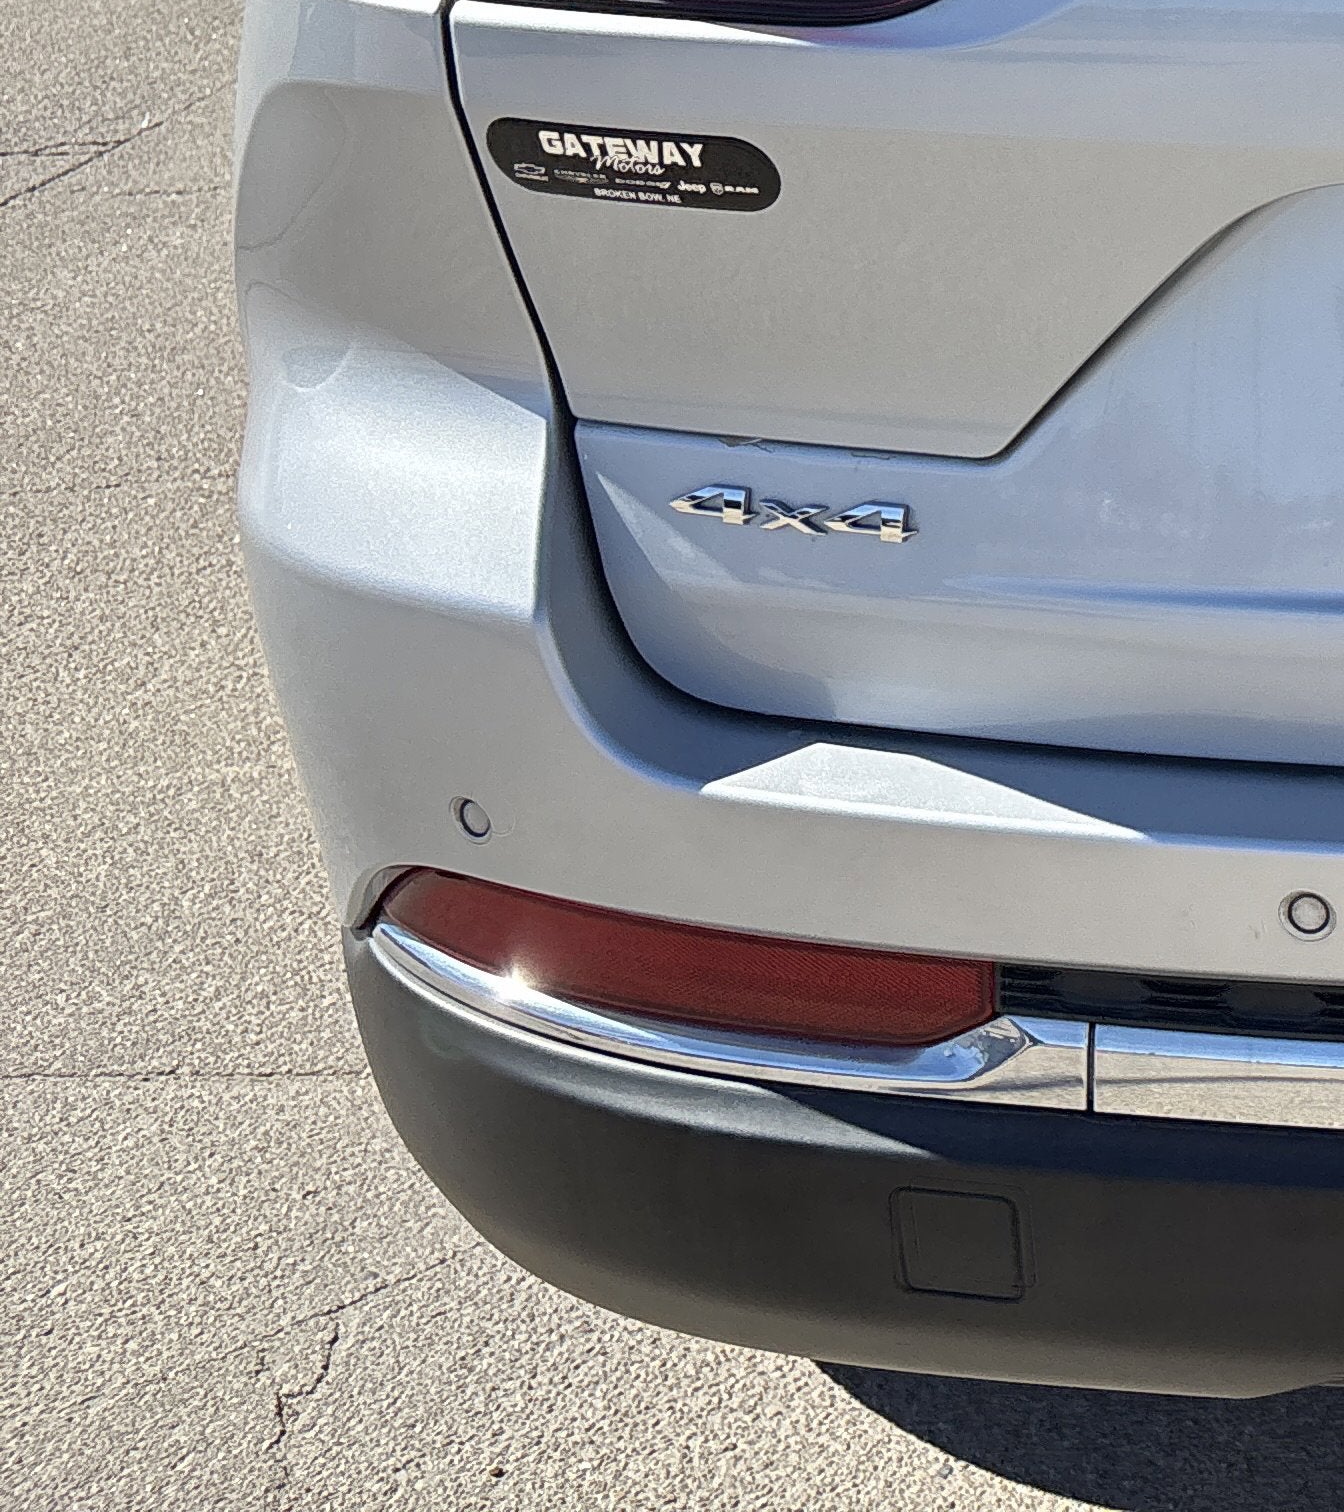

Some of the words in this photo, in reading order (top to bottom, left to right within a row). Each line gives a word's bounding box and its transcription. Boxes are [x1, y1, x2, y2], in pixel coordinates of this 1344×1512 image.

[538, 130, 704, 168] GATEWAY
[591, 152, 666, 176] Motors
[593, 187, 637, 201] BROKEN
[677, 179, 707, 195] Jeep
